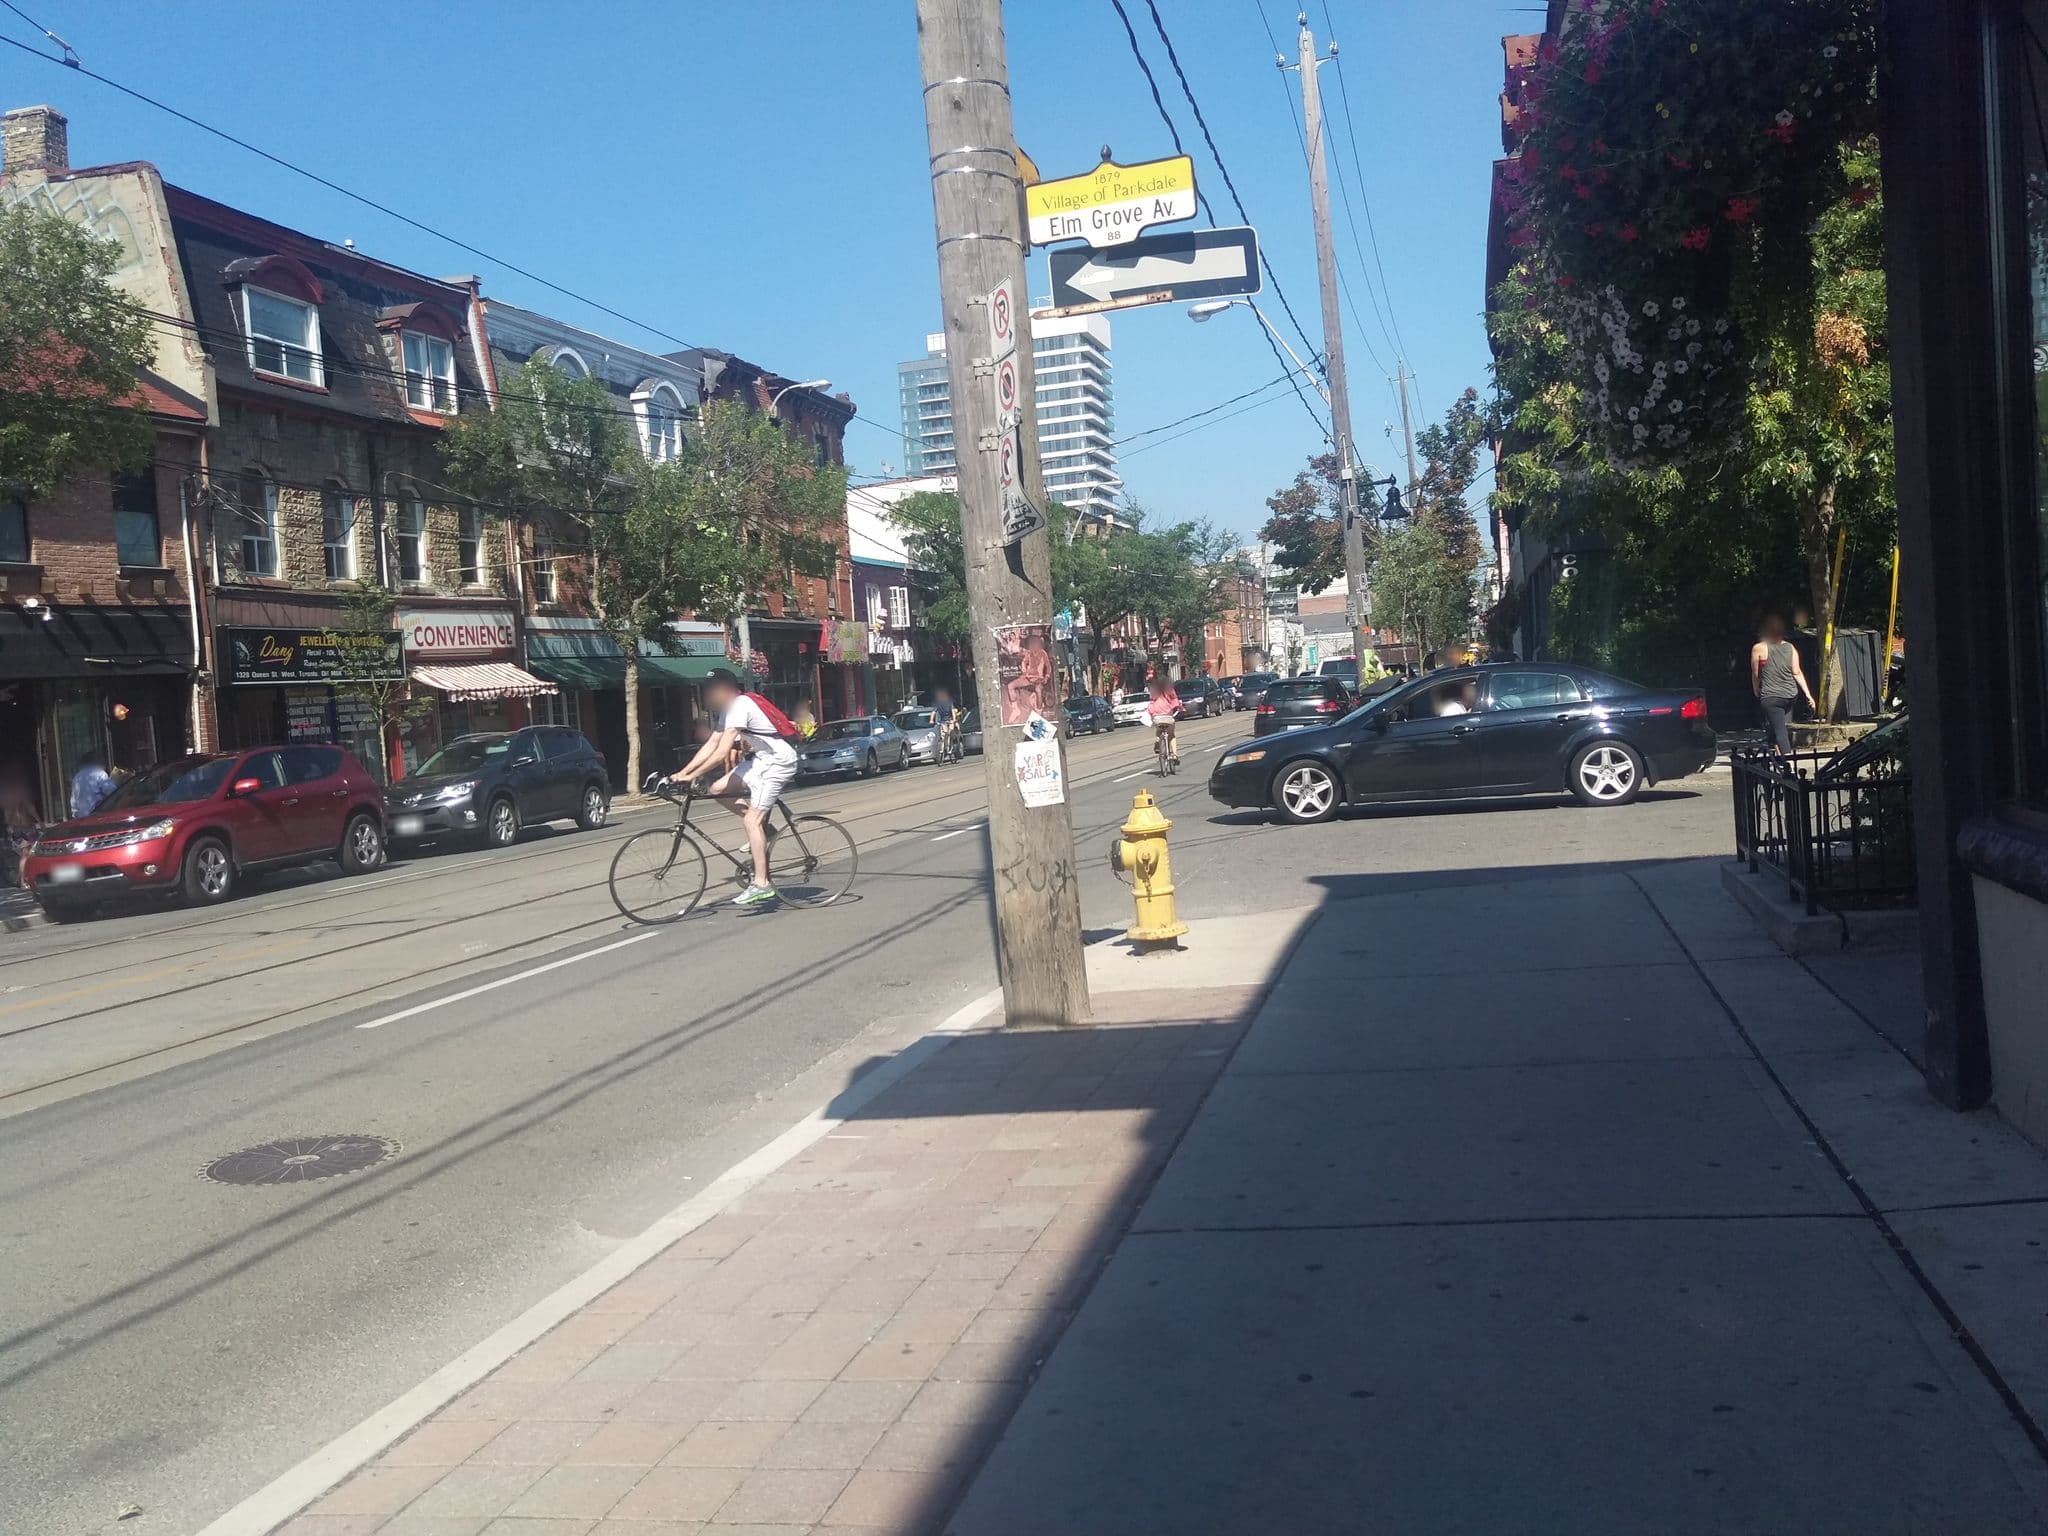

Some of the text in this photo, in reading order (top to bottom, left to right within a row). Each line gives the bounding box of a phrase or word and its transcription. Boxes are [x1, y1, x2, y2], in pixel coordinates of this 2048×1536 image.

[1094, 172, 1121, 185] 1879
[1041, 176, 1177, 211] Village of Parkdale
[1050, 199, 1176, 237] Elm Grove Av.
[1107, 230, 1121, 241] 88
[414, 625, 513, 647] CONVENIENCE
[259, 635, 295, 666] Dang
[1025, 765, 1052, 780] SALE
